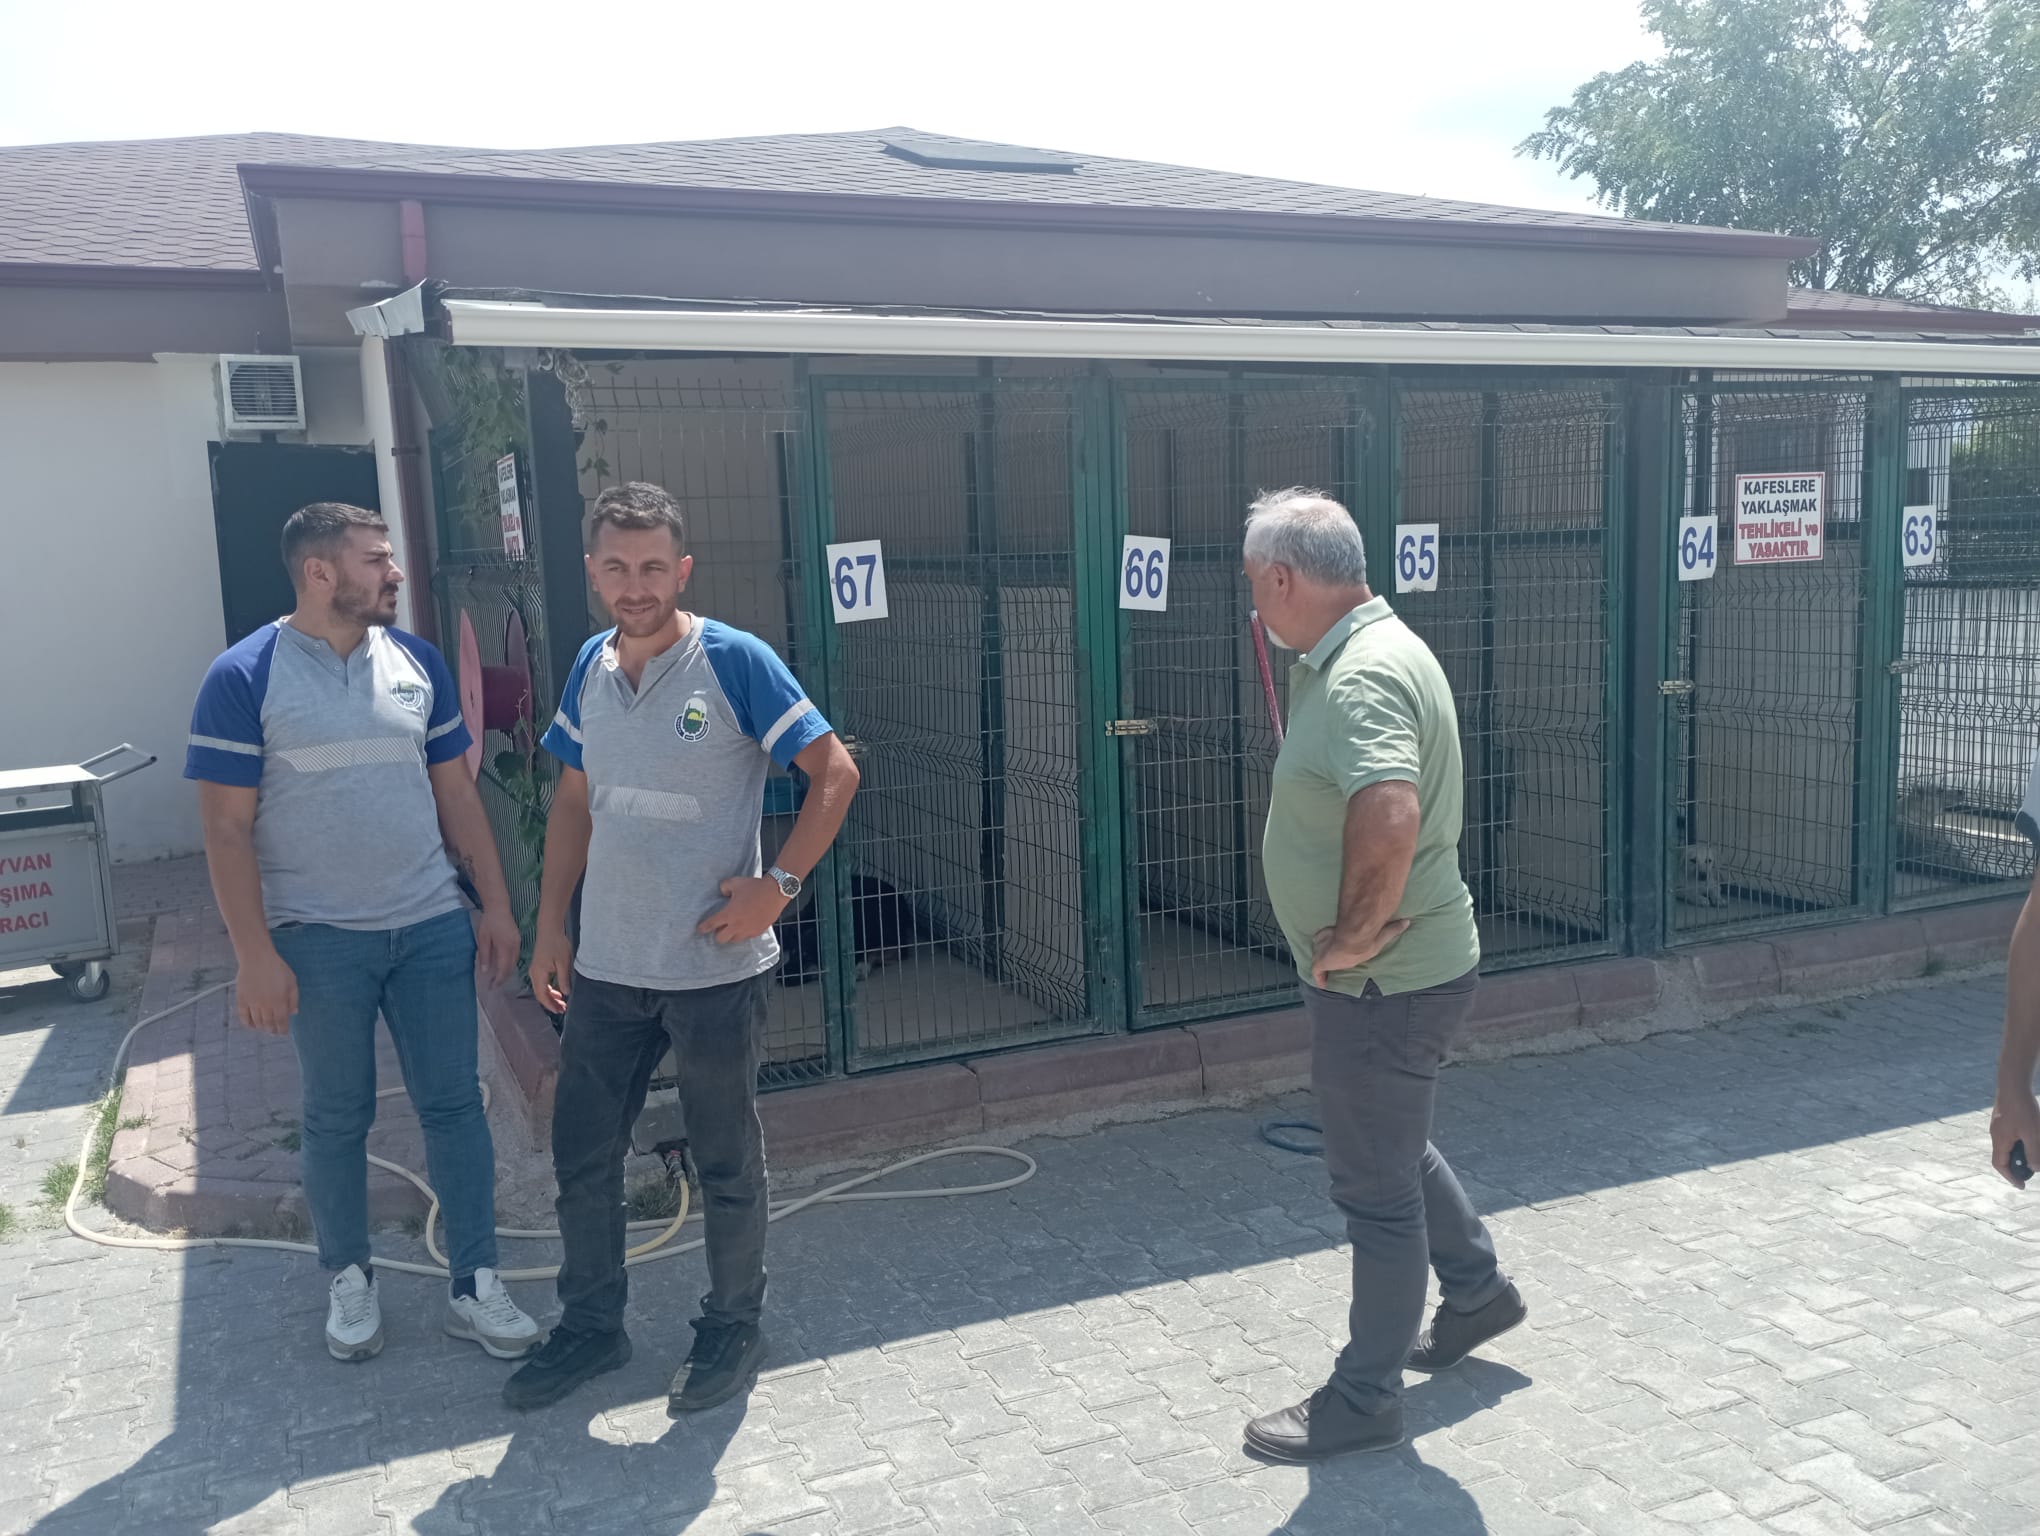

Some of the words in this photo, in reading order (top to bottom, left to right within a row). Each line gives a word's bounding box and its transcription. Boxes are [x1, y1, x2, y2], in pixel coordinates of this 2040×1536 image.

[1743, 479, 1816, 495] KAFESLERE
[1741, 499, 1818, 516] YAKLAŞMAK
[1739, 517, 1802, 539] TEHLİKELİ
[1805, 524, 1819, 536] ve
[1905, 515, 1933, 556] 63
[1399, 534, 1436, 581] 65
[1682, 525, 1714, 570] 64
[1748, 540, 1809, 559] YASAKTIR
[834, 554, 877, 610] 67
[1125, 548, 1164, 599] 66
[0, 881, 54, 909] ŞIMA
[0, 911, 49, 934] RACI
